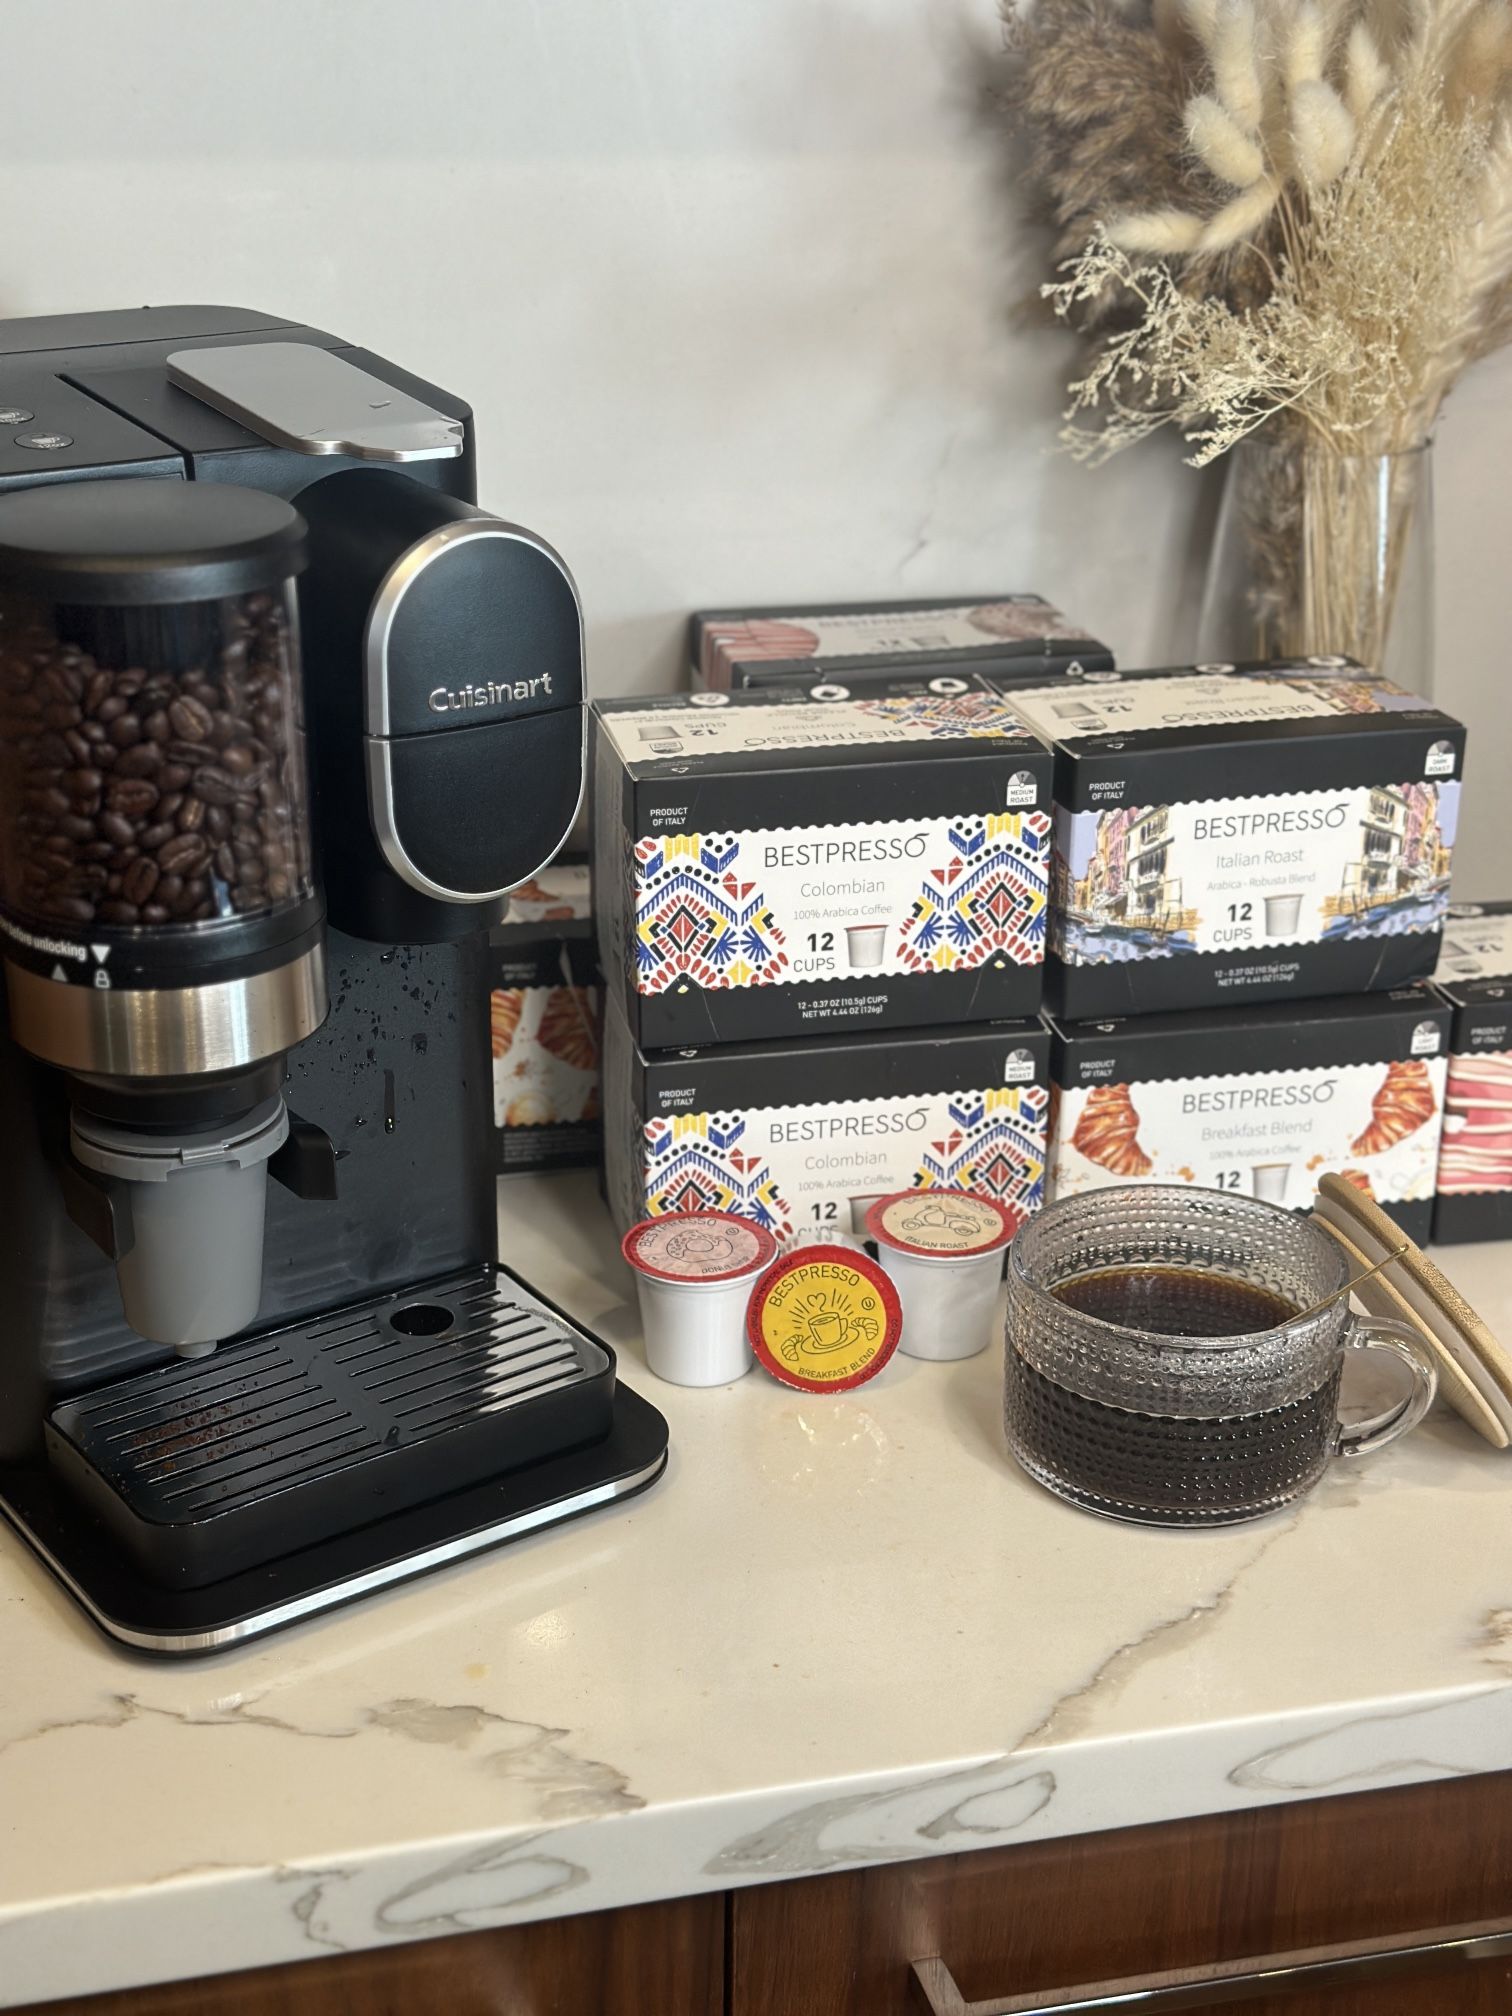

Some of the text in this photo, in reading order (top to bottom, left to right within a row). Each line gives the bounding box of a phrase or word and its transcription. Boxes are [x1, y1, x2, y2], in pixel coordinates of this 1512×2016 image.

[429, 672, 552, 712] Cuisinart
[689, 729, 719, 737] 12
[1089, 781, 1126, 790] PRODUCT
[1092, 791, 1124, 800] OF ITALY
[650, 807, 688, 816] PRODUCT
[652, 817, 686, 826] OF ITALY
[1216, 849, 1304, 869] Italian Roast
[800, 879, 885, 898] Colombian
[1207, 879, 1242, 891] Arabica
[1248, 876, 1286, 887] Robusta
[1288, 872, 1316, 884] Blend
[793, 903, 893, 921] 100% Arabica Coffee
[1227, 903, 1253, 922] 12
[807, 932, 834, 952] 12
[1213, 927, 1253, 943] CUPS
[33, 936, 87, 962] unlocking
[793, 957, 836, 973] CUPS
[797, 1001, 806, 1010] 12
[812, 1000, 829, 1009] 0.37
[829, 999, 840, 1007] OZ
[866, 995, 888, 1004] CUPS
[802, 1009, 817, 1018] NET
[819, 1008, 831, 1017] WT
[832, 1007, 848, 1016] 4.44
[849, 1006, 859, 1015] OZ
[1470, 1025, 1507, 1036] PRODUCT
[1472, 1036, 1482, 1045] OF
[1080, 1059, 1116, 1070] PRODUCT
[1081, 1069, 1113, 1079] OF ITALY
[659, 1088, 697, 1098] PRODUCT
[661, 1098, 694, 1108] OF ITALY
[1201, 1118, 1313, 1141] Breakfast Blend
[1236, 1147, 1270, 1158] Arabica
[1271, 1145, 1302, 1156] Coffee
[804, 1152, 887, 1170] Colombian
[798, 1175, 894, 1192] 100% Arabica Coffee
[1216, 1171, 1241, 1189] 12
[811, 1202, 838, 1221] 12
[639, 1218, 717, 1248] BESTPRESSO
[904, 1236, 937, 1249] ITALIAN
[768, 1265, 860, 1307] BESTPRESSO
[798, 1347, 876, 1379] BREAKFAST BLEND
